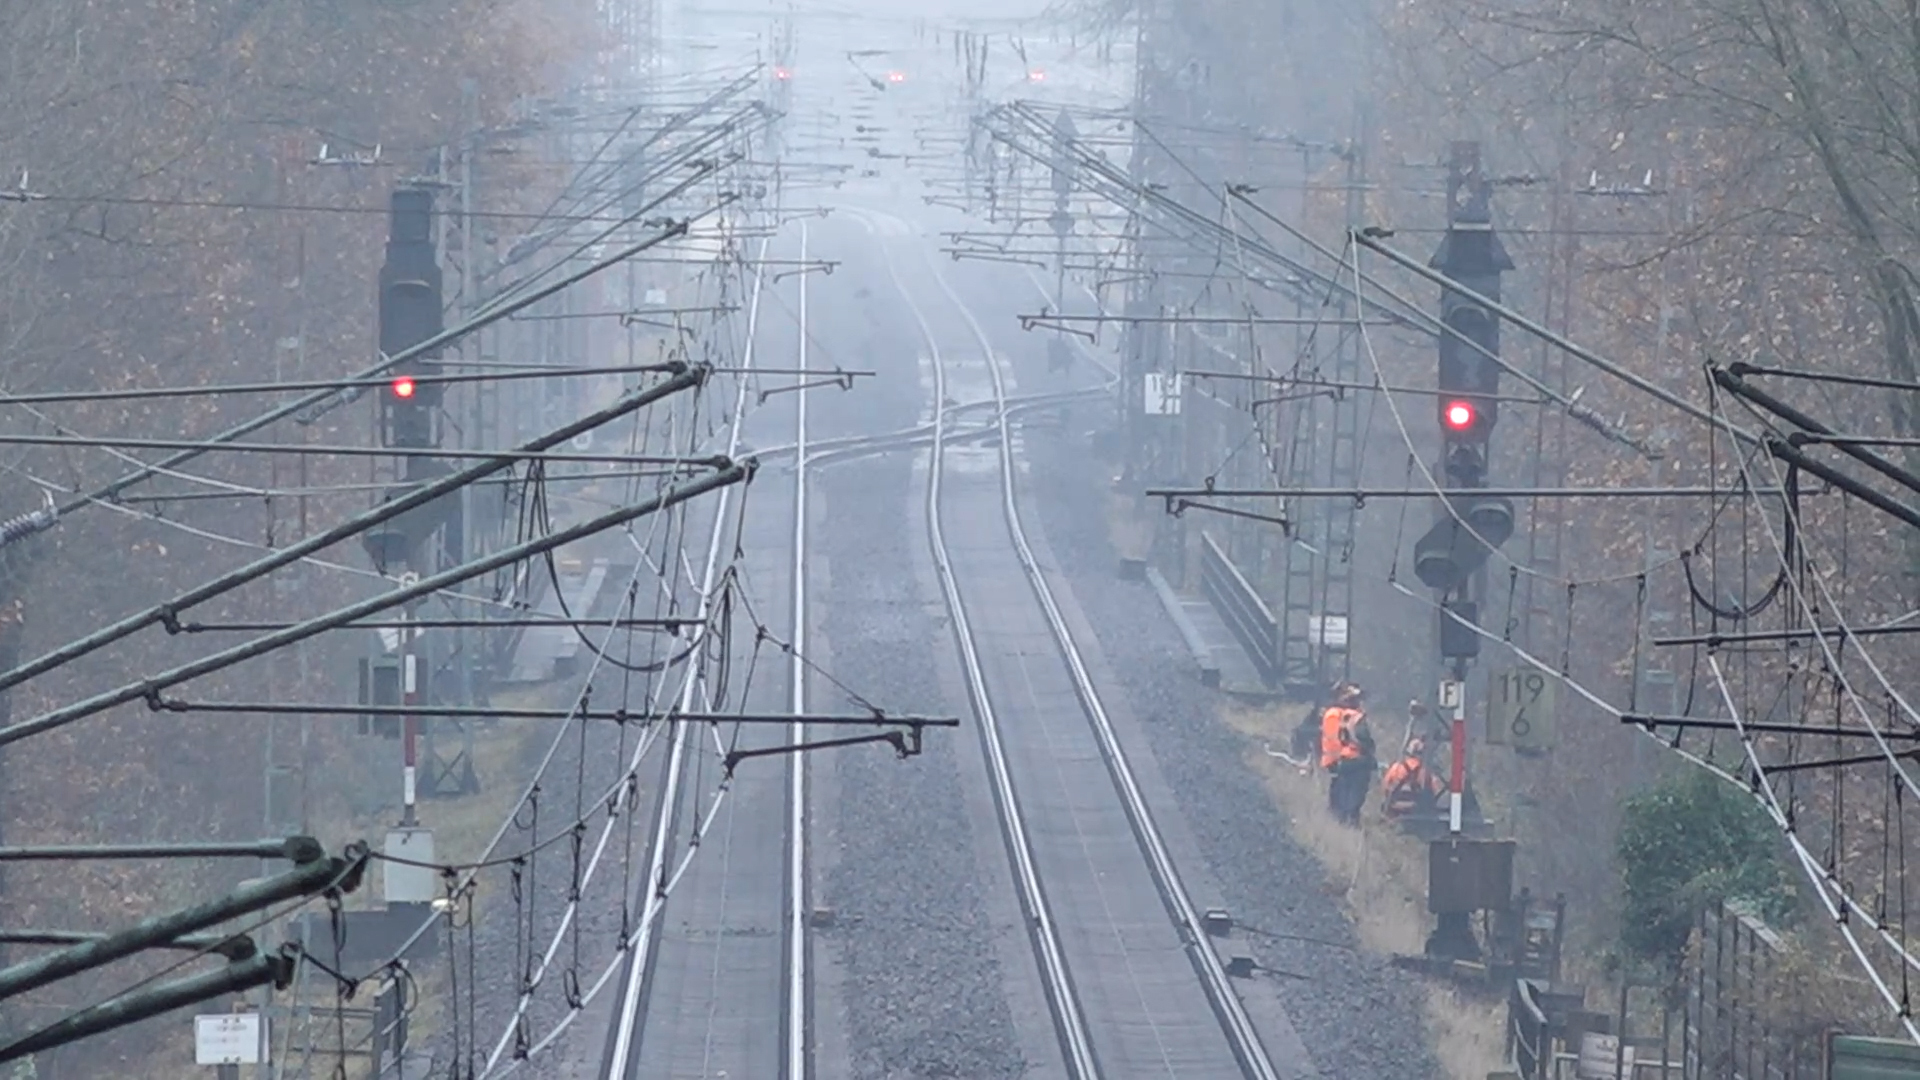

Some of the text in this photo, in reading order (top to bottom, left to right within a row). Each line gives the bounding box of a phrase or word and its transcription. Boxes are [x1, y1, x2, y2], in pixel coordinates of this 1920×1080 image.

[1444, 682, 1455, 705] F
[1499, 673, 1545, 703] 119
[1511, 706, 1531, 736] 6
